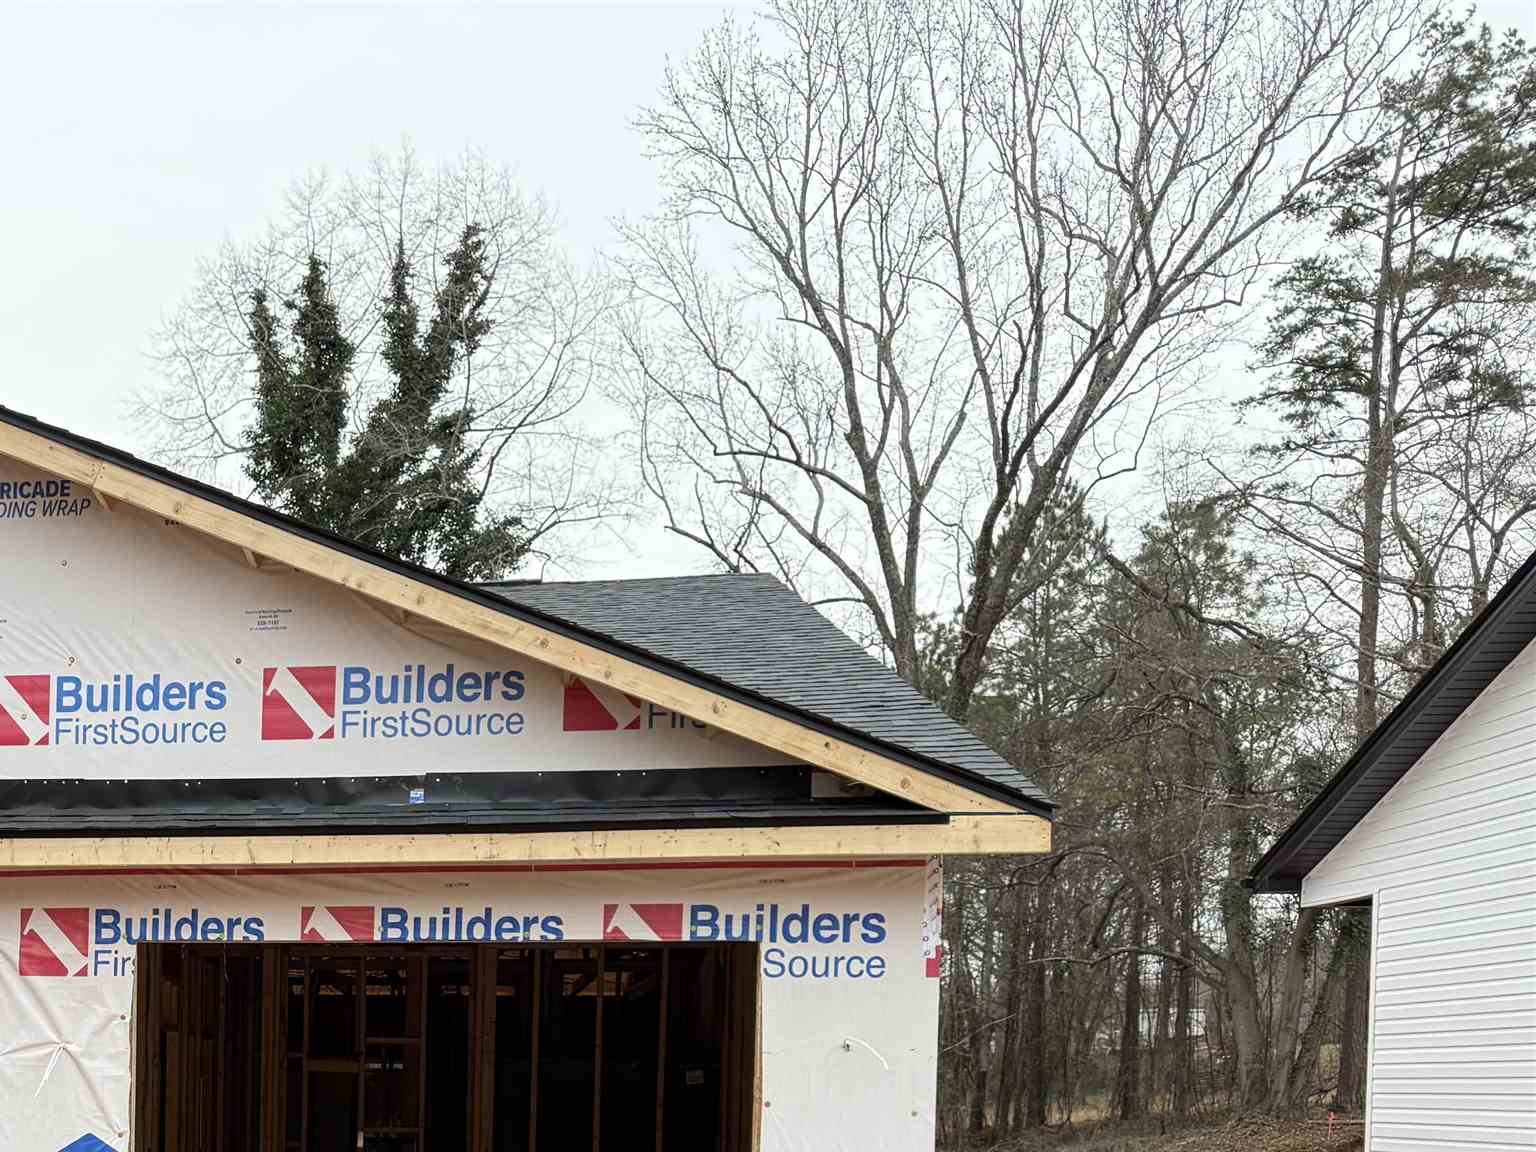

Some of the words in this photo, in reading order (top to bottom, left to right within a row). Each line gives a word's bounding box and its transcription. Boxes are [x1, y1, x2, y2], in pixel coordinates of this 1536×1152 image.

[42, 498, 91, 517] WRAP
[55, 672, 227, 713] Builders
[343, 664, 526, 704] Builders
[54, 715, 227, 746] FirstSource
[340, 708, 525, 739] FirstSource
[95, 908, 265, 945] Builders
[380, 906, 564, 943] Builders
[689, 903, 887, 944] Builders
[94, 949, 136, 977] Fir
